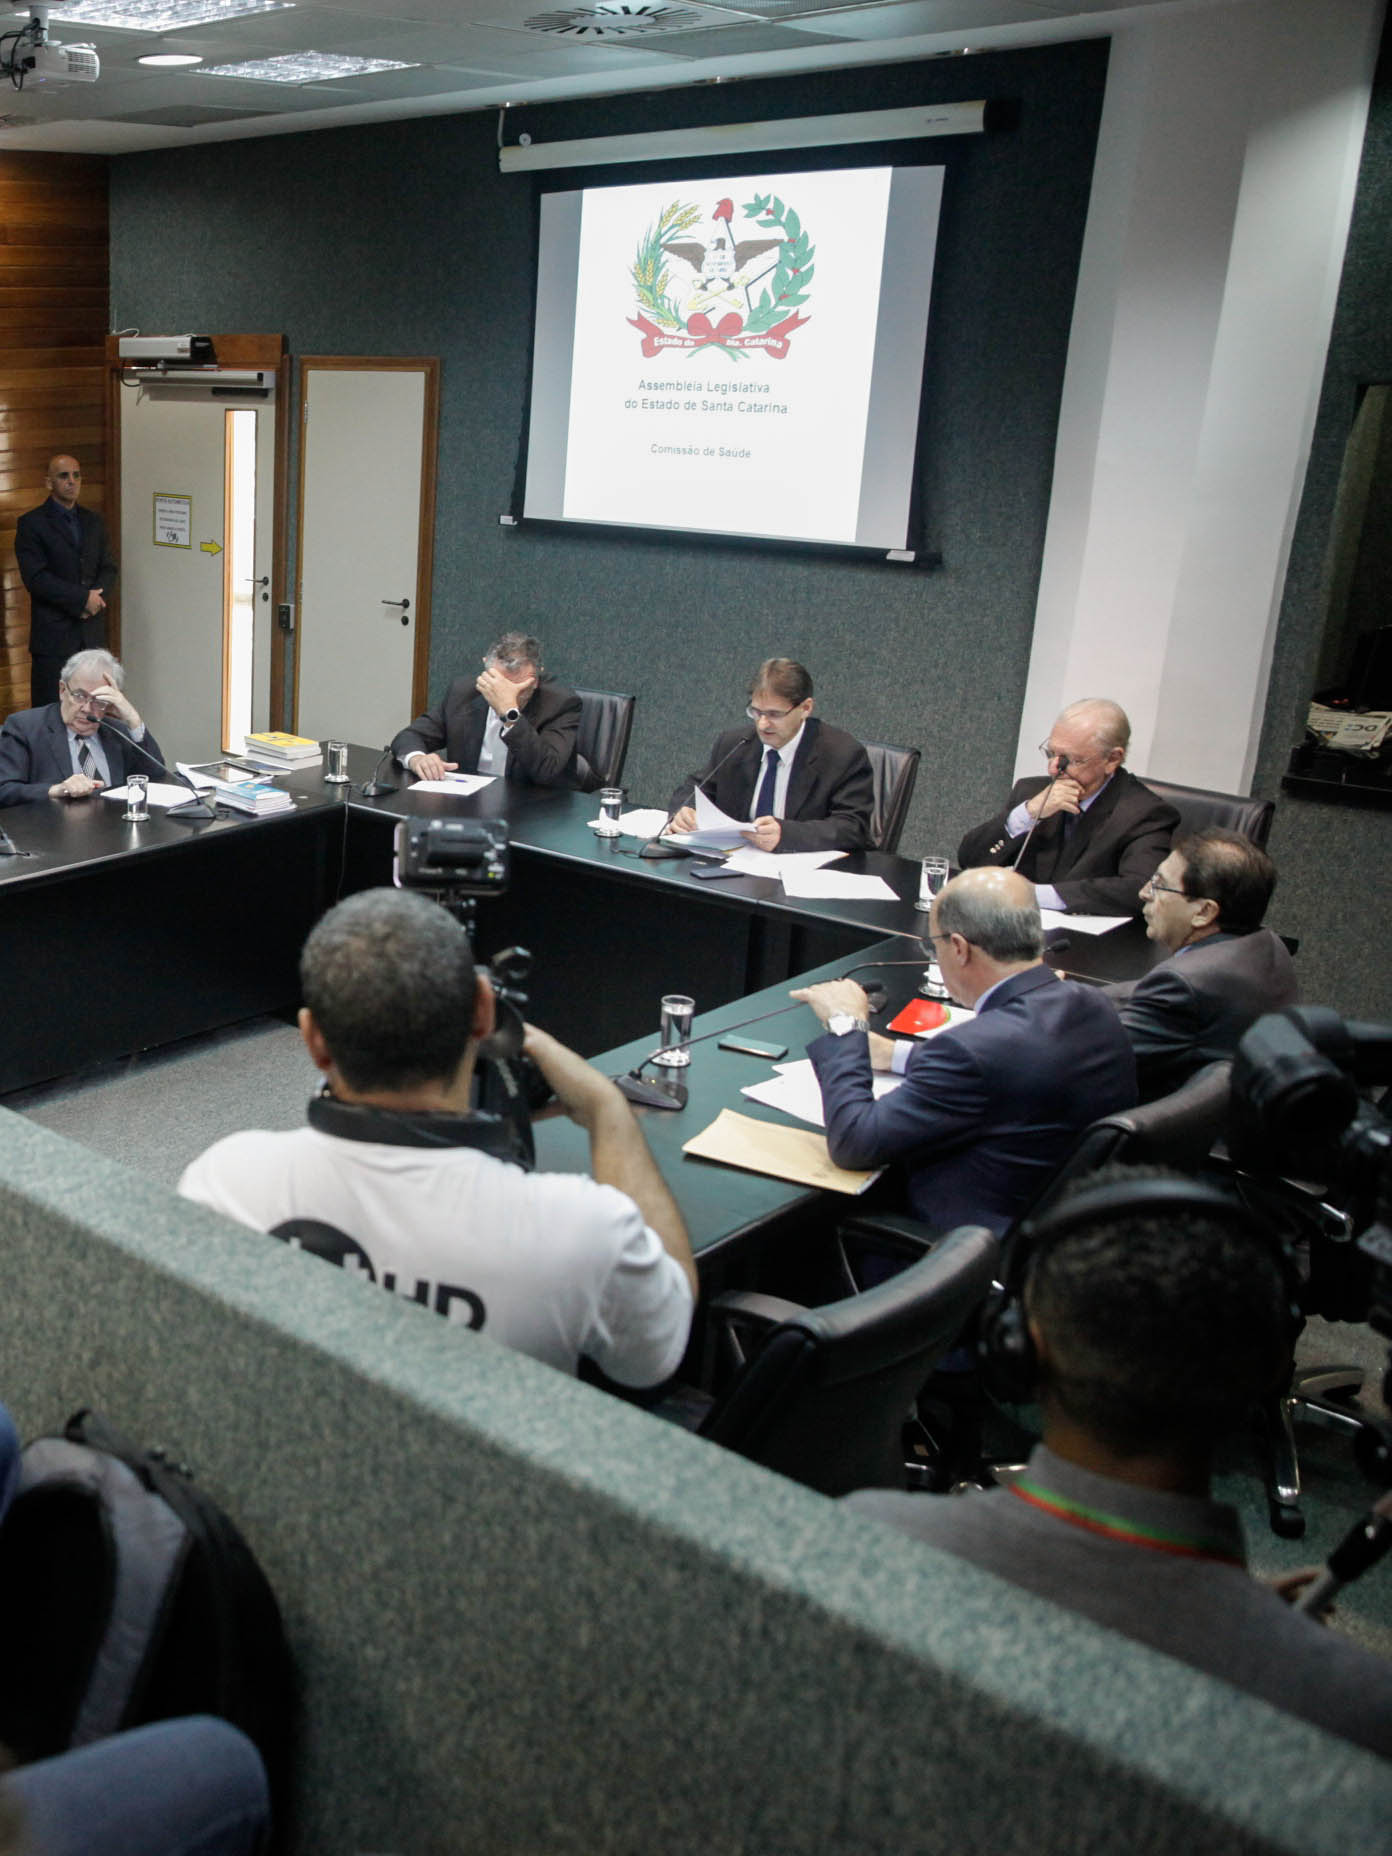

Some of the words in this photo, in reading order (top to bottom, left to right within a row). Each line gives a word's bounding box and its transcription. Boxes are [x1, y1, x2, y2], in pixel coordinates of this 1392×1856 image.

[638, 379, 702, 391] Assembleia
[707, 381, 770, 395] Legislativa
[624, 398, 638, 409] do
[641, 398, 680, 410] Estado
[684, 400, 697, 411] de
[701, 400, 733, 412] Santa
[737, 401, 788, 414] Catarina
[650, 443, 700, 456] Comissão
[703, 446, 715, 457] de
[718, 446, 752, 459] Saúde
